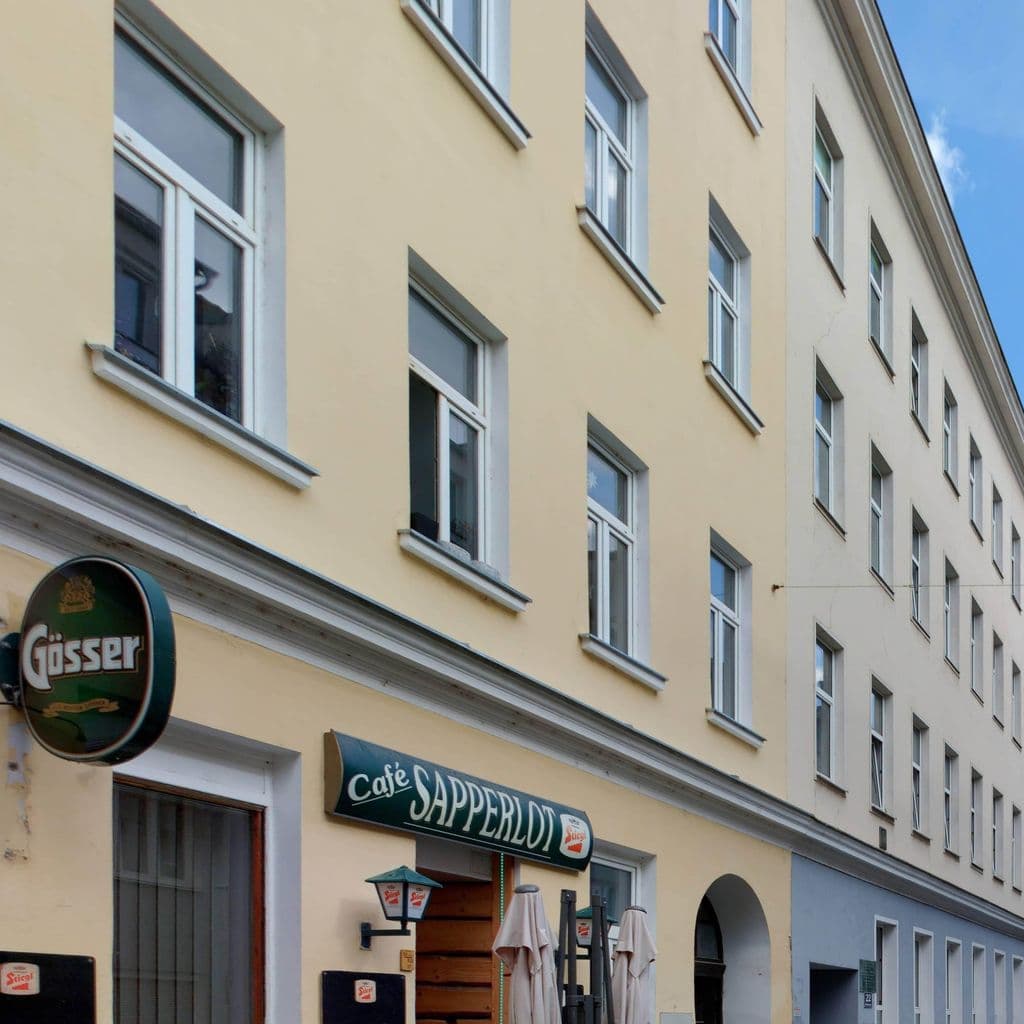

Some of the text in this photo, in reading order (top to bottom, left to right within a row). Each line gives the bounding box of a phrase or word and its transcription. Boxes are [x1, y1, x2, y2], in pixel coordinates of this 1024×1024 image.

[22, 624, 141, 690] Gösser
[347, 761, 556, 852] Café SAPPERLOT
